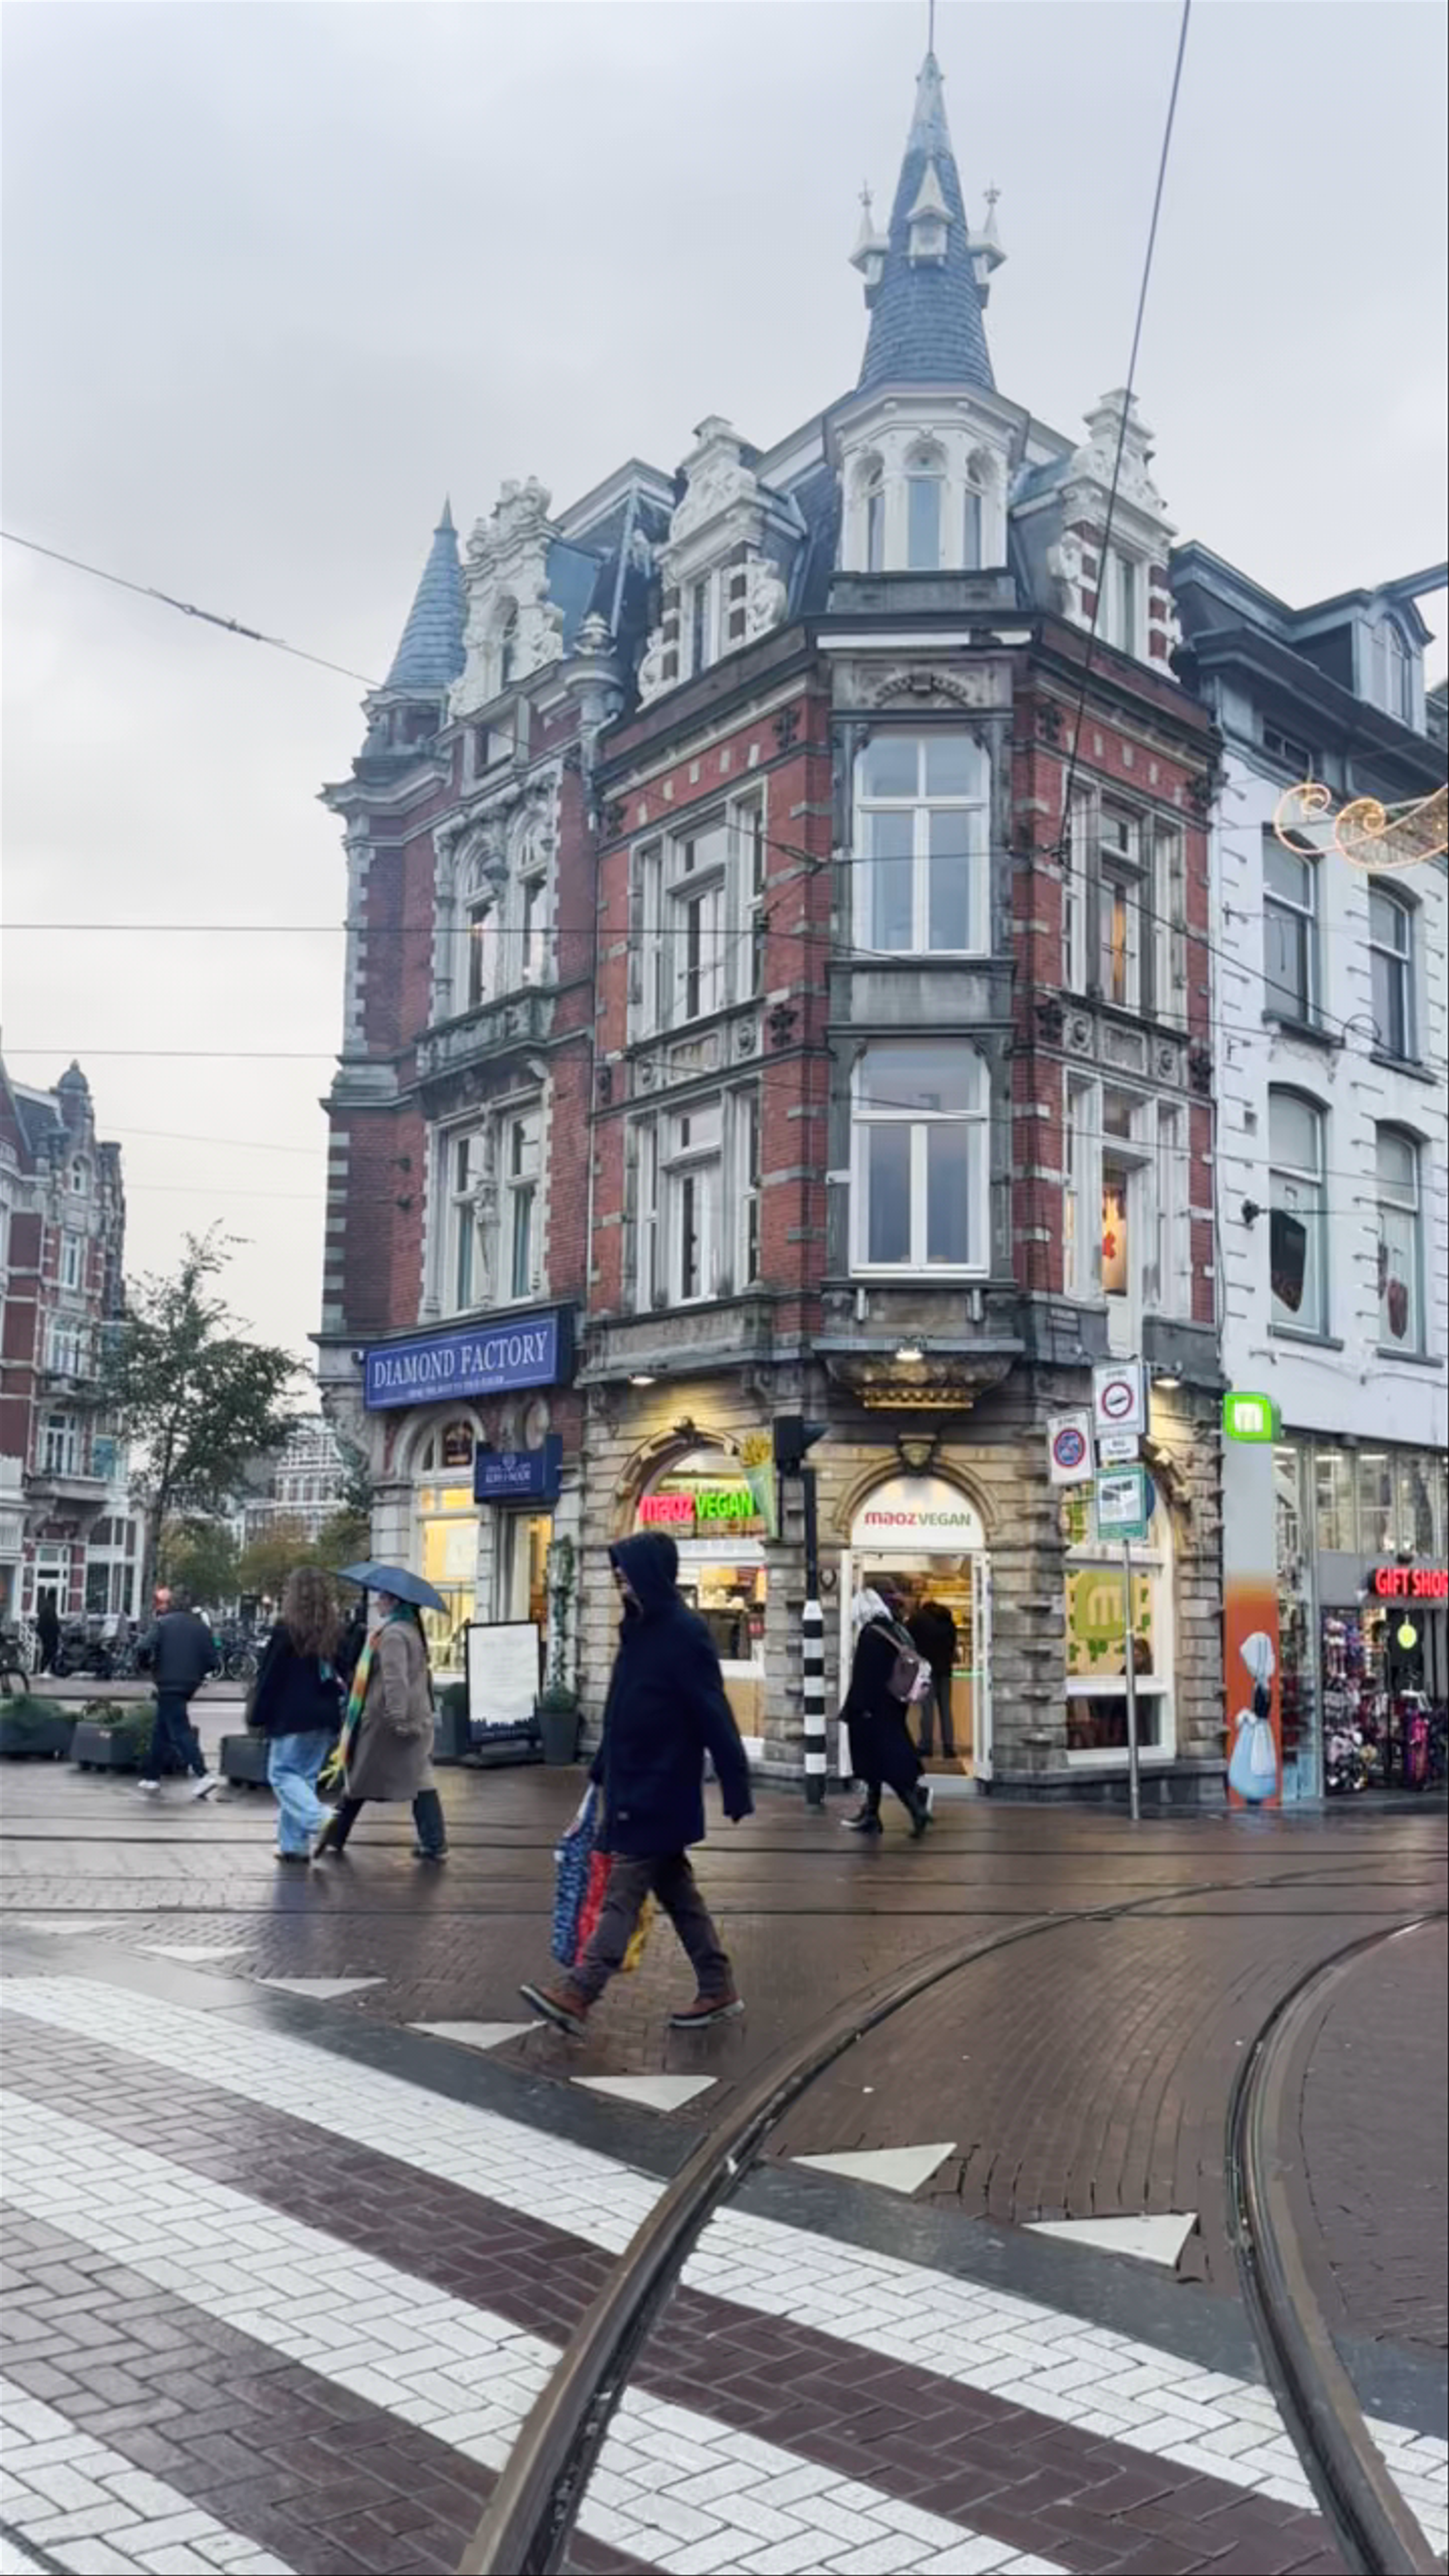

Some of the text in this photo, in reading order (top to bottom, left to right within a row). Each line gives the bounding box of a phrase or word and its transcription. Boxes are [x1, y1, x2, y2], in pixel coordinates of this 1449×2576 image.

[374, 1349, 454, 1389] DIAMOND
[460, 1331, 548, 1374] FACTORY
[696, 1490, 753, 1519] VEGAN
[864, 1512, 971, 1526] maoz VEGAN
[1376, 1568, 1409, 1595] GIFT
